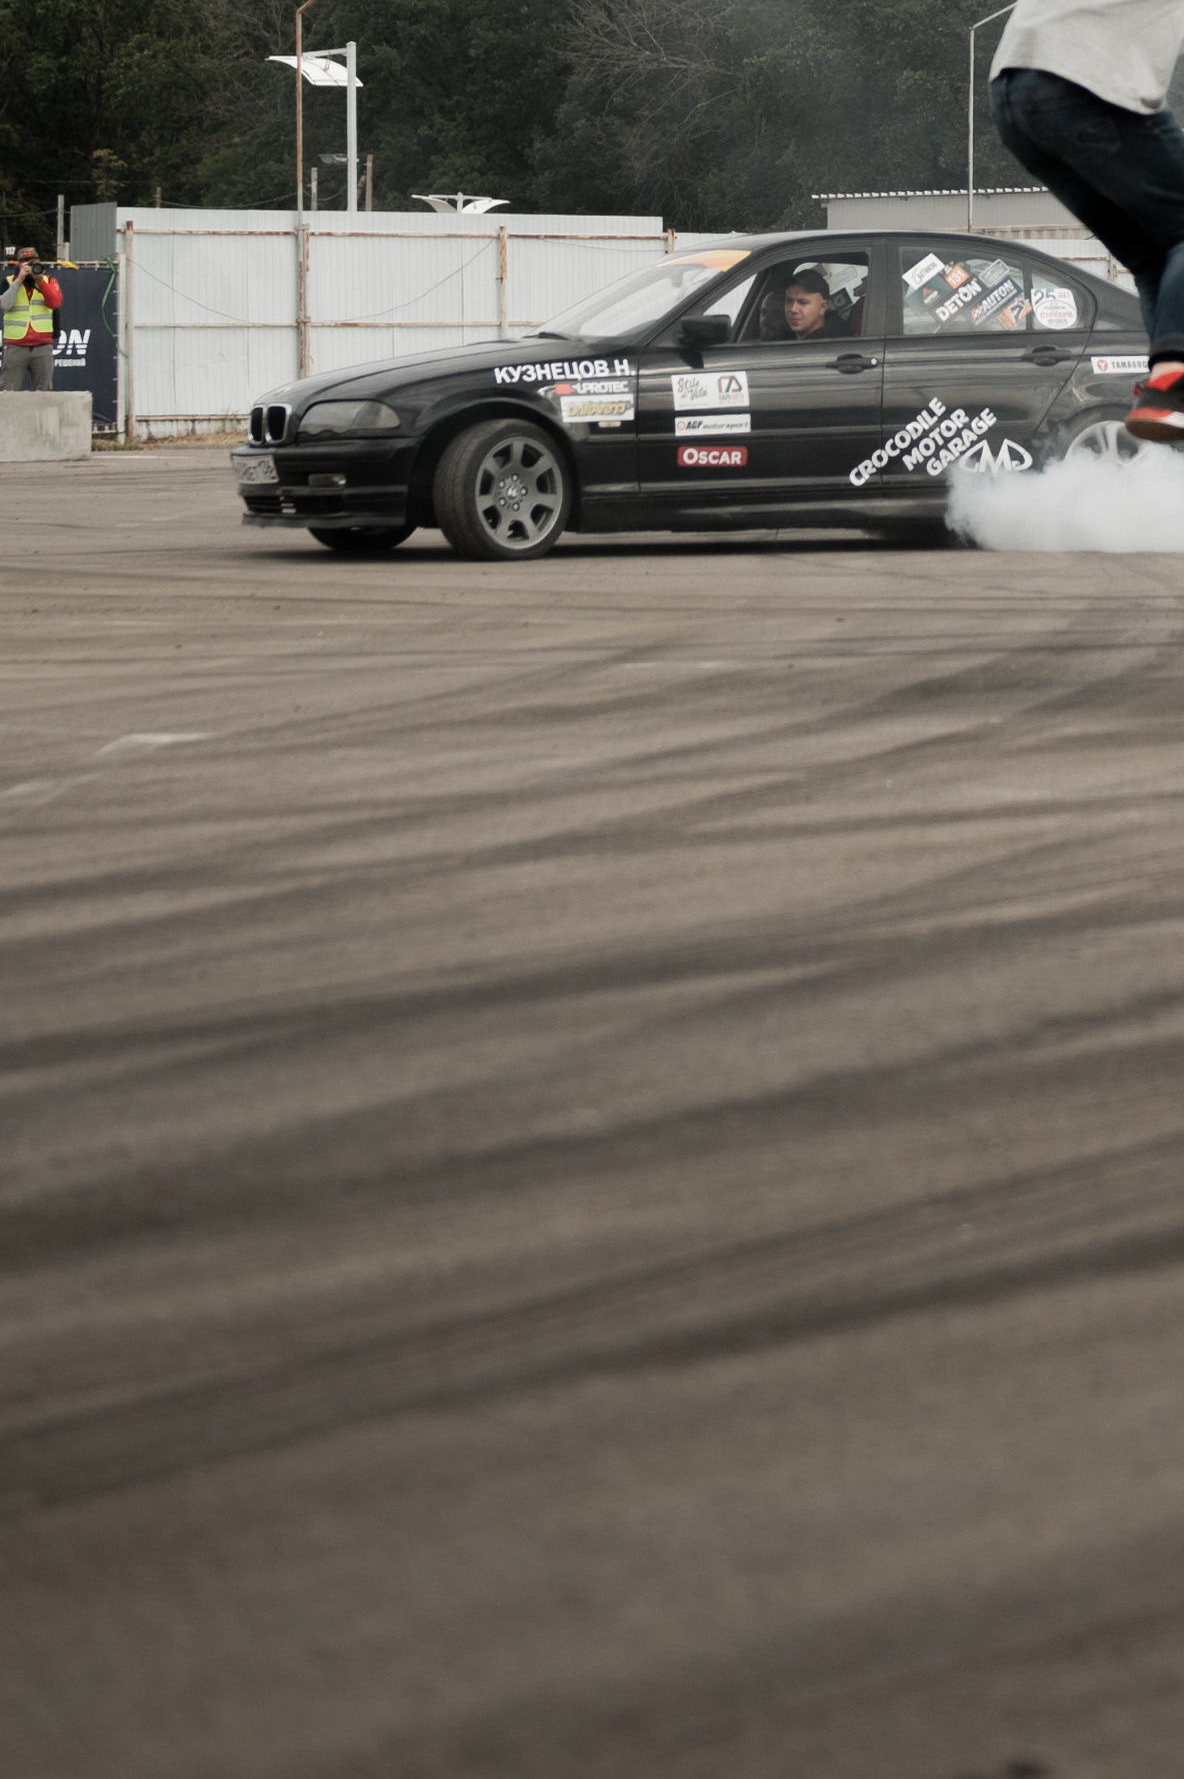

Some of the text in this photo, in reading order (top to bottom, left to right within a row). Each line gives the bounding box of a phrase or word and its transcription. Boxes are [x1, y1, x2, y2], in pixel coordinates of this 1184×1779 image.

[947, 269, 966, 286] 131
[982, 280, 1015, 313] AUTON
[1033, 287, 1056, 306] 25
[494, 359, 636, 384] КУЗНЕЦОВ Н.
[703, 421, 748, 432] motorsport
[849, 396, 946, 486] CROCODILE
[902, 408, 970, 471] MOTOR
[926, 407, 997, 476] GARAGE
[683, 448, 742, 465] OSCAR
